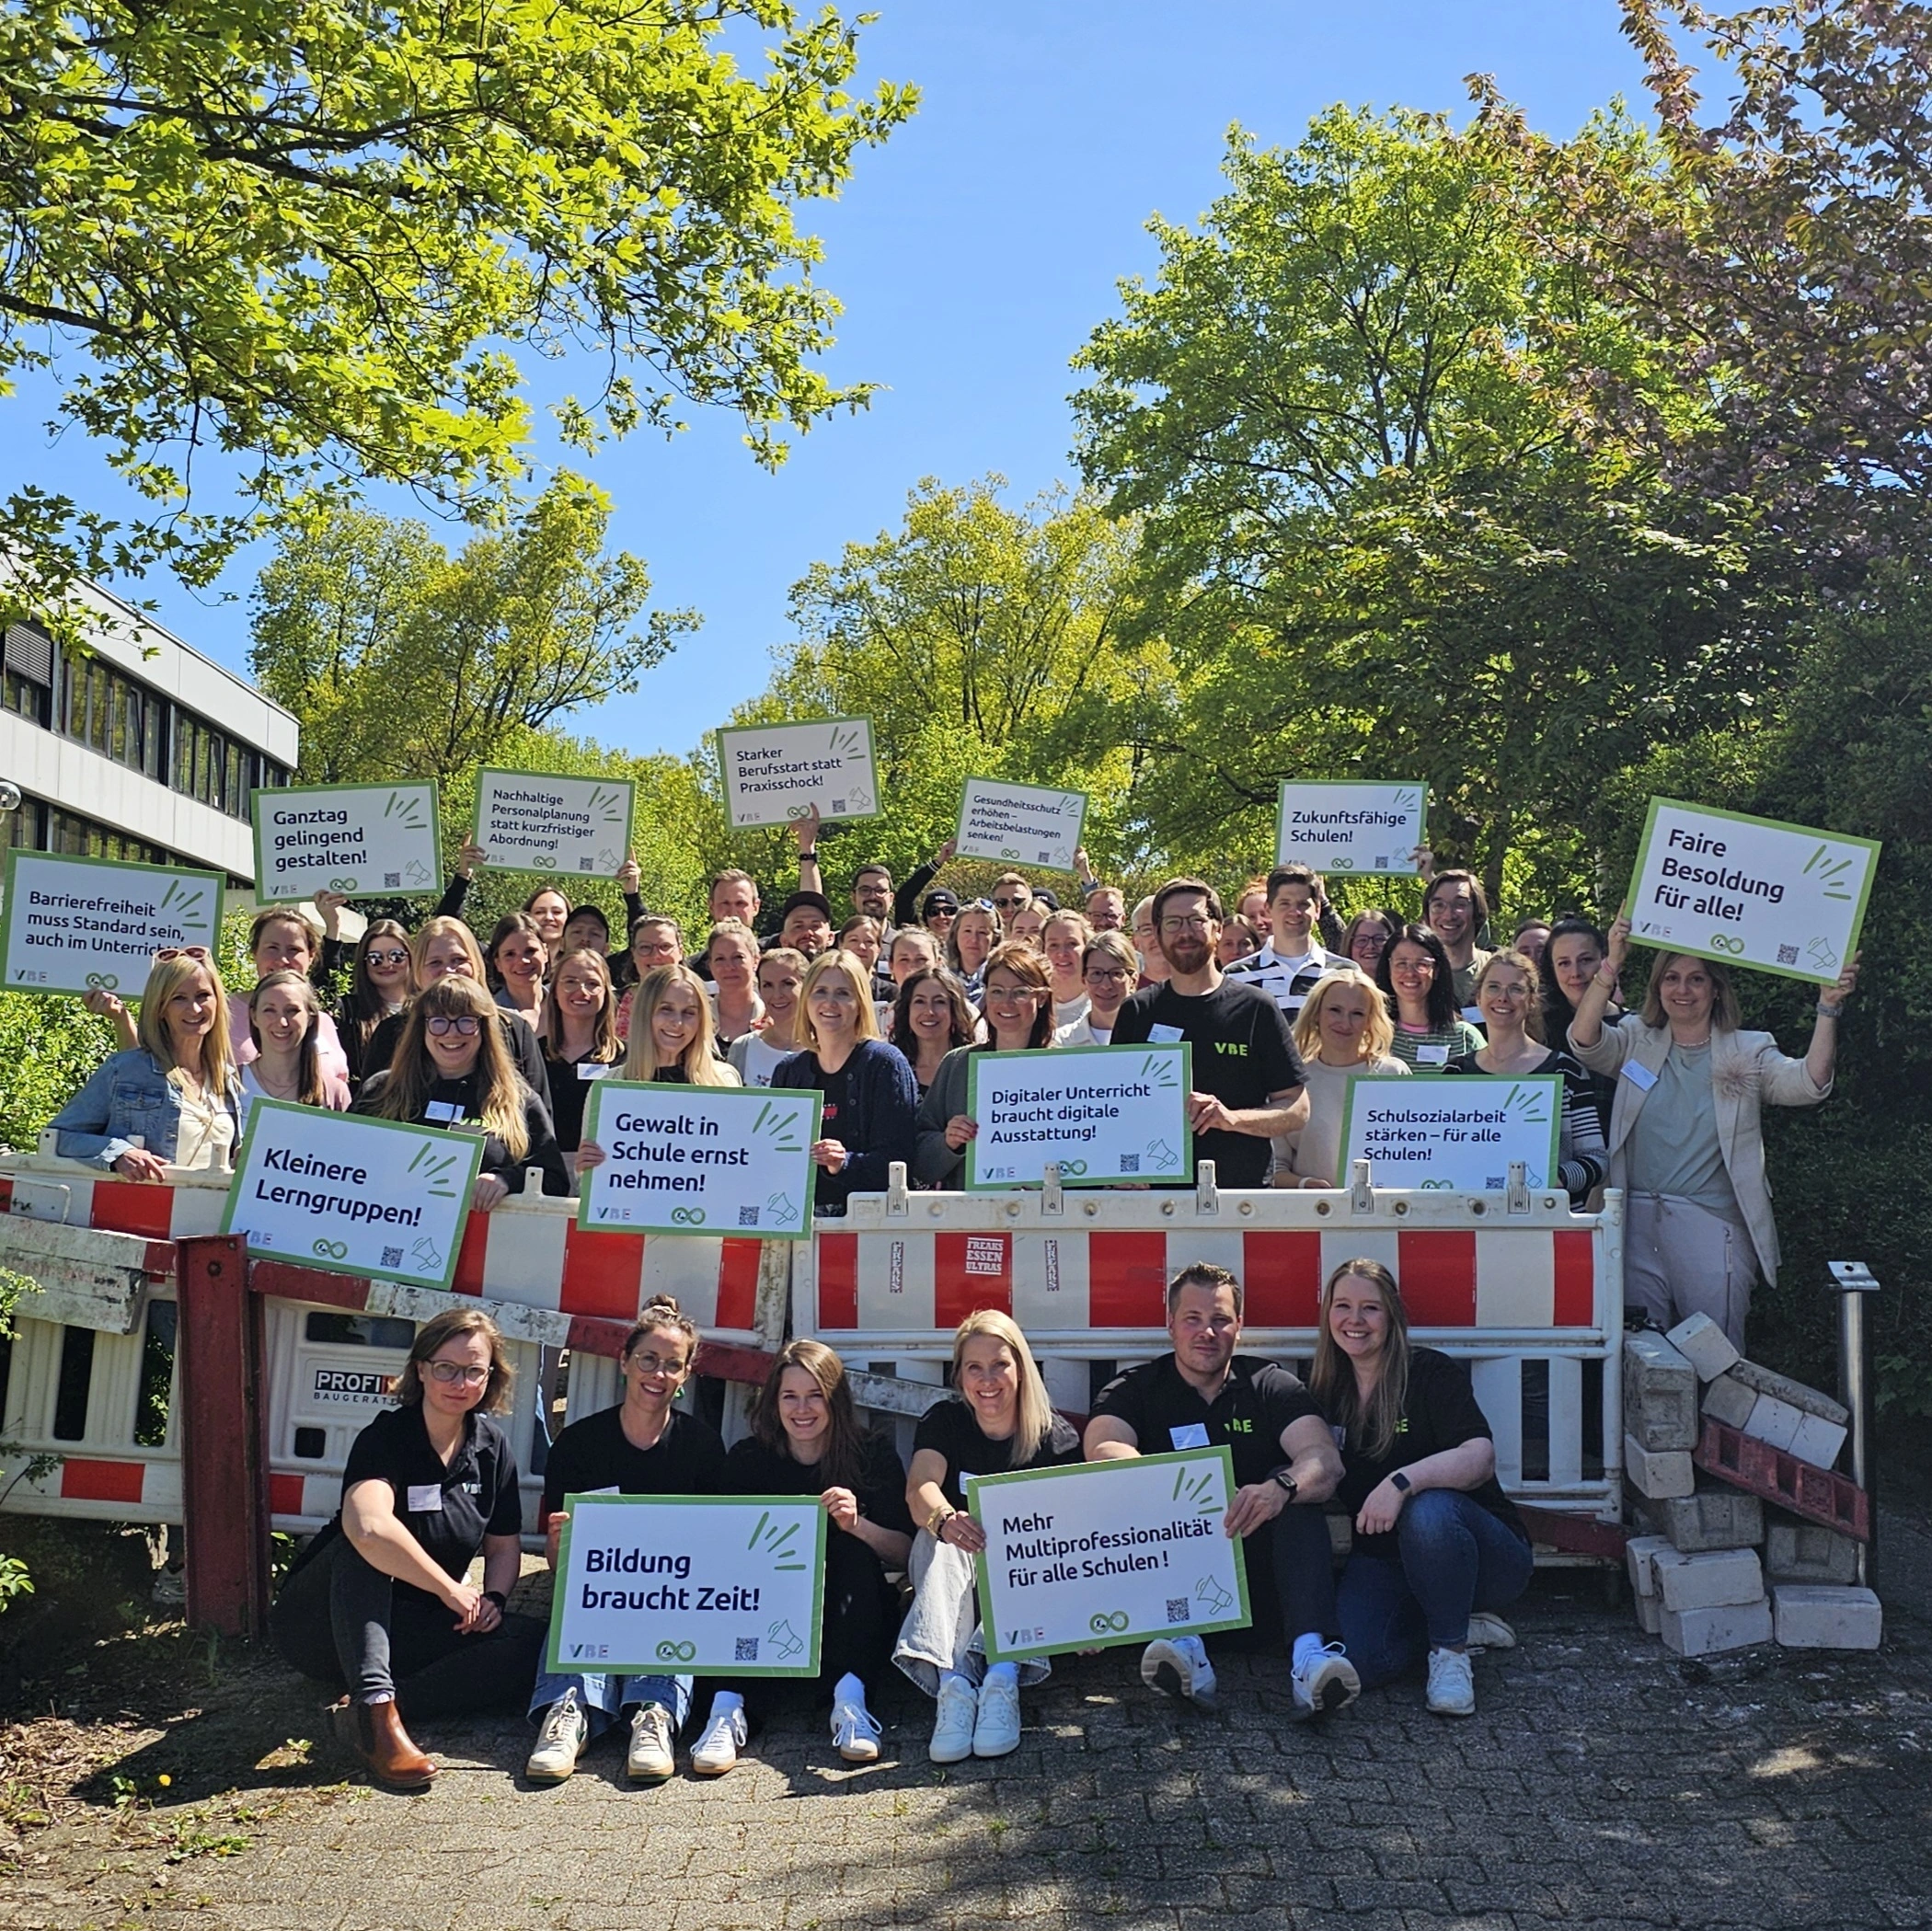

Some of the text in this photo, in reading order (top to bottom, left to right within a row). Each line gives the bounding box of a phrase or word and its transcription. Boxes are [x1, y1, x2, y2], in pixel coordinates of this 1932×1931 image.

[736, 747, 783, 762] Starker
[738, 758, 842, 777] Berufsstart statt
[740, 776, 823, 793] Praxisschock!
[493, 789, 564, 806] Nachhaltige
[973, 795, 1062, 815] Gesundheitsschutz
[273, 810, 348, 825] Ganztag
[491, 804, 590, 824] Personalplanung
[972, 807, 1010, 820] erhöhen
[1292, 810, 1407, 827] Zukunftsfähige
[274, 827, 363, 850] gelingend
[490, 819, 595, 839] statt kurzfristiger
[967, 831, 1004, 843] senken!
[969, 819, 1061, 839] Arbeitsbelastungen
[1291, 829, 1352, 843] Schulen!
[489, 833, 558, 851] Abordnung!
[1668, 828, 1727, 857] Faire
[275, 850, 367, 872] gestalten!
[270, 884, 297, 895] VBE
[1662, 857, 1785, 903] Besoldung
[29, 891, 155, 917] Barrierefreiheit
[1654, 885, 1744, 922] für alle!
[28, 914, 185, 942] muss Standard sein,
[1639, 921, 1673, 937] VBE
[26, 933, 63, 948] auch
[68, 935, 87, 949] im
[14, 969, 48, 983] VBE
[1214, 1042, 1248, 1056] VBE
[992, 1083, 1151, 1106] Digitaler Unterricht
[991, 1104, 1120, 1124] braucht digitale
[1367, 1109, 1507, 1123] Schulsozialarbeit
[615, 1113, 719, 1136] Gewalt in
[990, 1125, 1097, 1144] Ausstattung!
[1365, 1128, 1427, 1142] stärken
[1443, 1128, 1468, 1142] für
[1471, 1129, 1501, 1142] alle
[612, 1141, 750, 1166] Schule ernst
[1364, 1147, 1432, 1161] Schulen!
[263, 1148, 367, 1185] Kleinere
[983, 1167, 1016, 1179] VBE
[609, 1169, 706, 1192] nehmen!
[255, 1178, 422, 1227] Lerngruppen!
[596, 1207, 631, 1221] VBE
[967, 1241, 1004, 1251] FREAKS
[966, 1250, 1003, 1262] ESSEN
[966, 1262, 1002, 1271] ULTRAS
[316, 1372, 381, 1393] PROFI
[1003, 1513, 1054, 1535] Mehr
[1006, 1519, 1213, 1562] Multiprofessionalität
[585, 1547, 691, 1580] Bildung
[1008, 1569, 1038, 1588] für
[1042, 1563, 1078, 1584] alle
[1082, 1554, 1159, 1578] Schulen
[581, 1584, 760, 1612] braucht Zeit!
[1005, 1626, 1045, 1646] VBE
[569, 1644, 609, 1658] VBE
